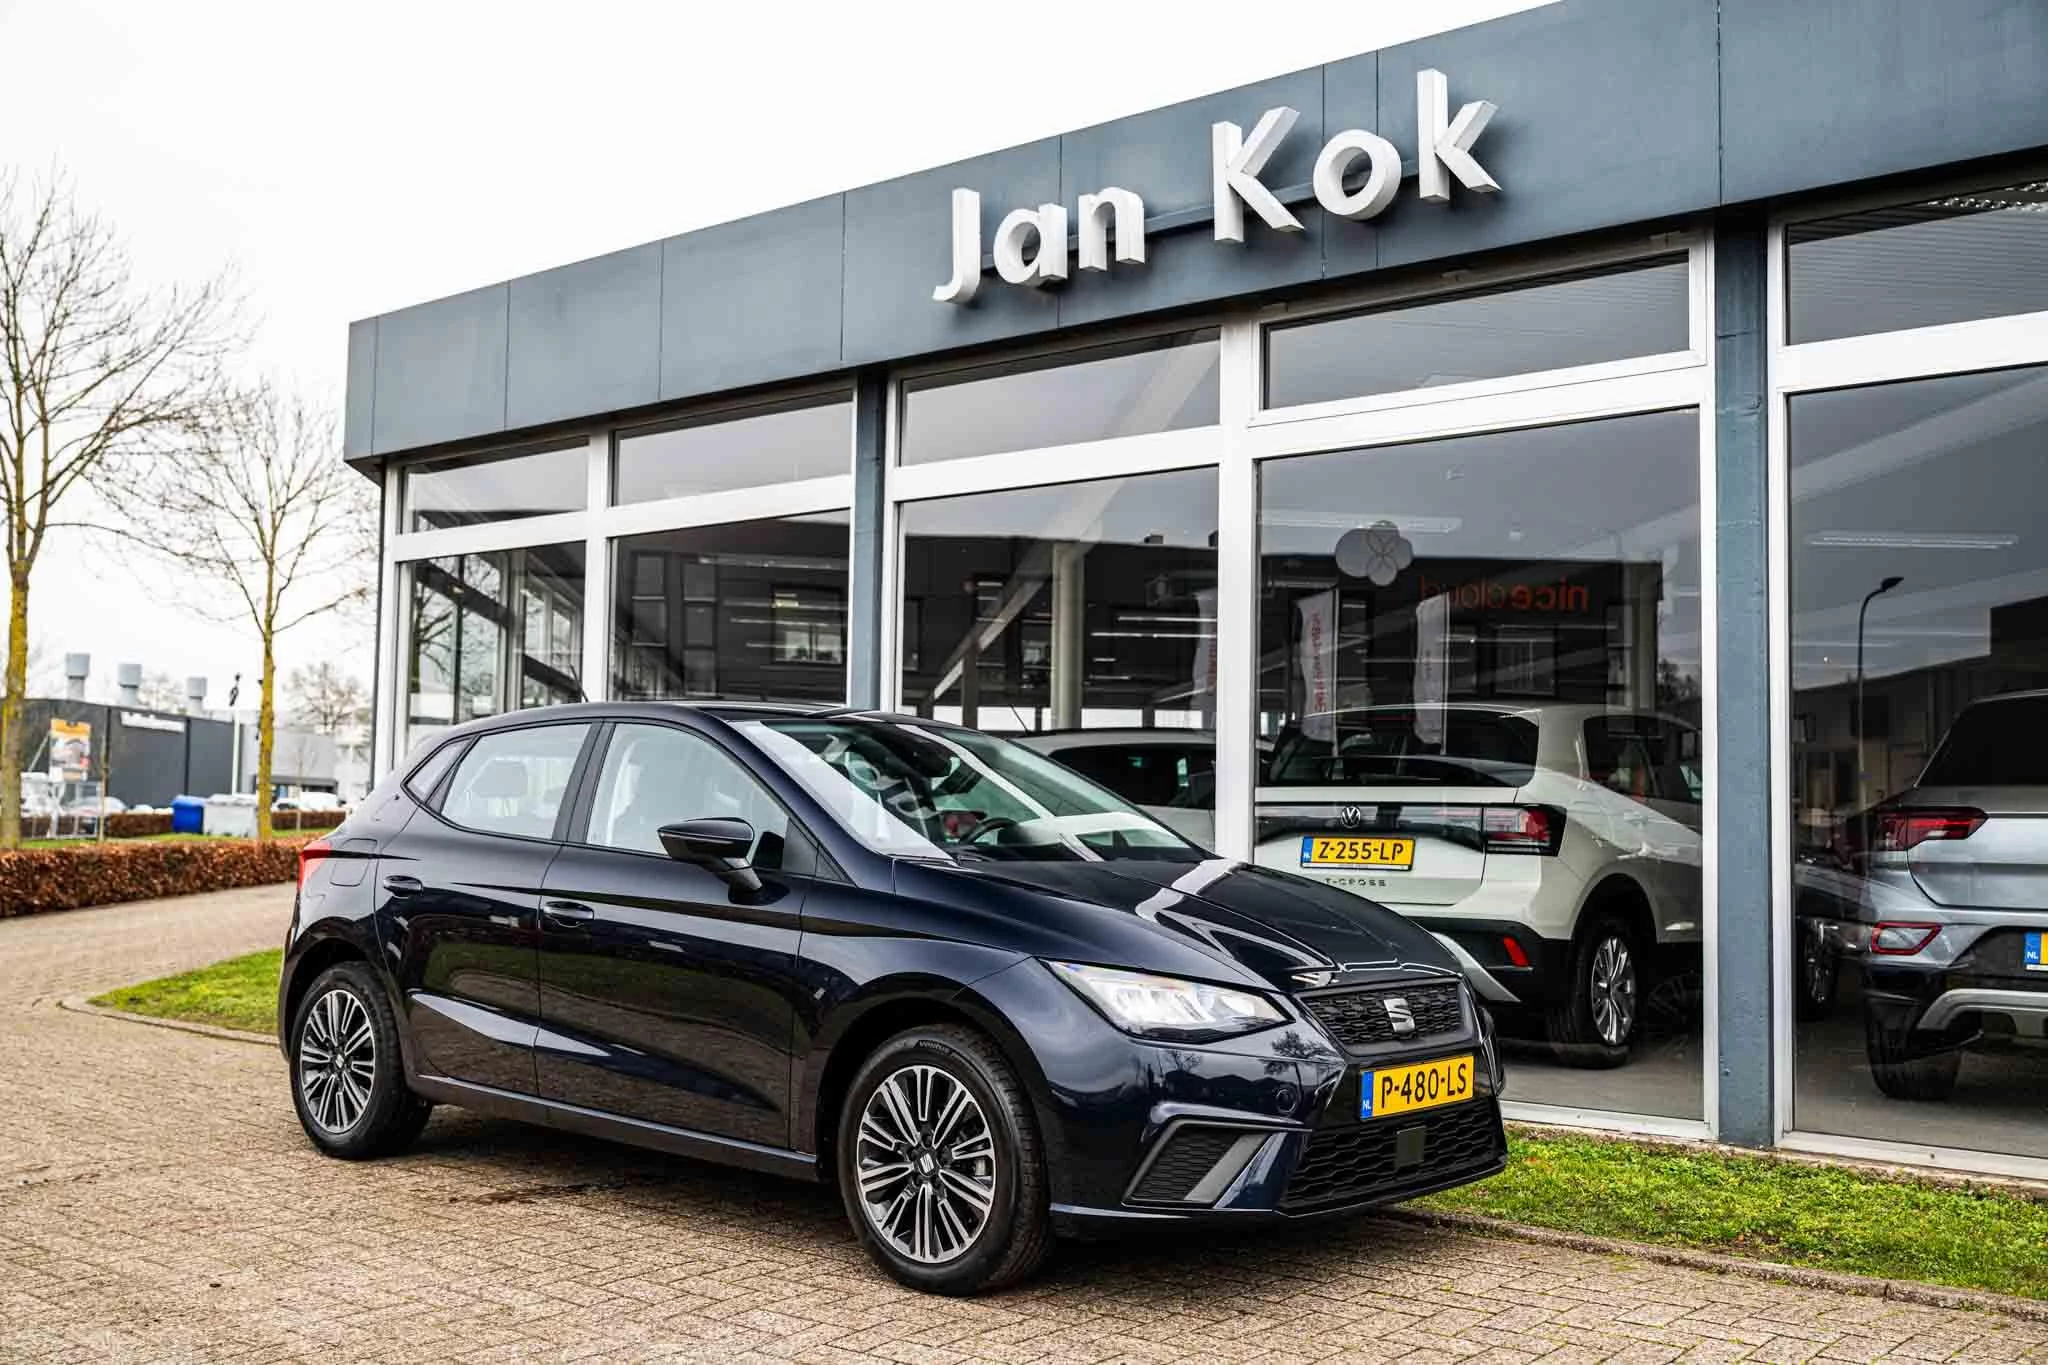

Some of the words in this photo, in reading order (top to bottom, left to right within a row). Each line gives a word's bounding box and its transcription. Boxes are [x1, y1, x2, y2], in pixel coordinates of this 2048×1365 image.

[932, 187, 1145, 302] Jan
[1212, 68, 1503, 243] Kok
[1318, 842, 1404, 860] Z-255-LP
[2026, 951, 2039, 960] NL
[1381, 1063, 1467, 1109] P-480-LS
[1362, 1099, 1372, 1111] NL
